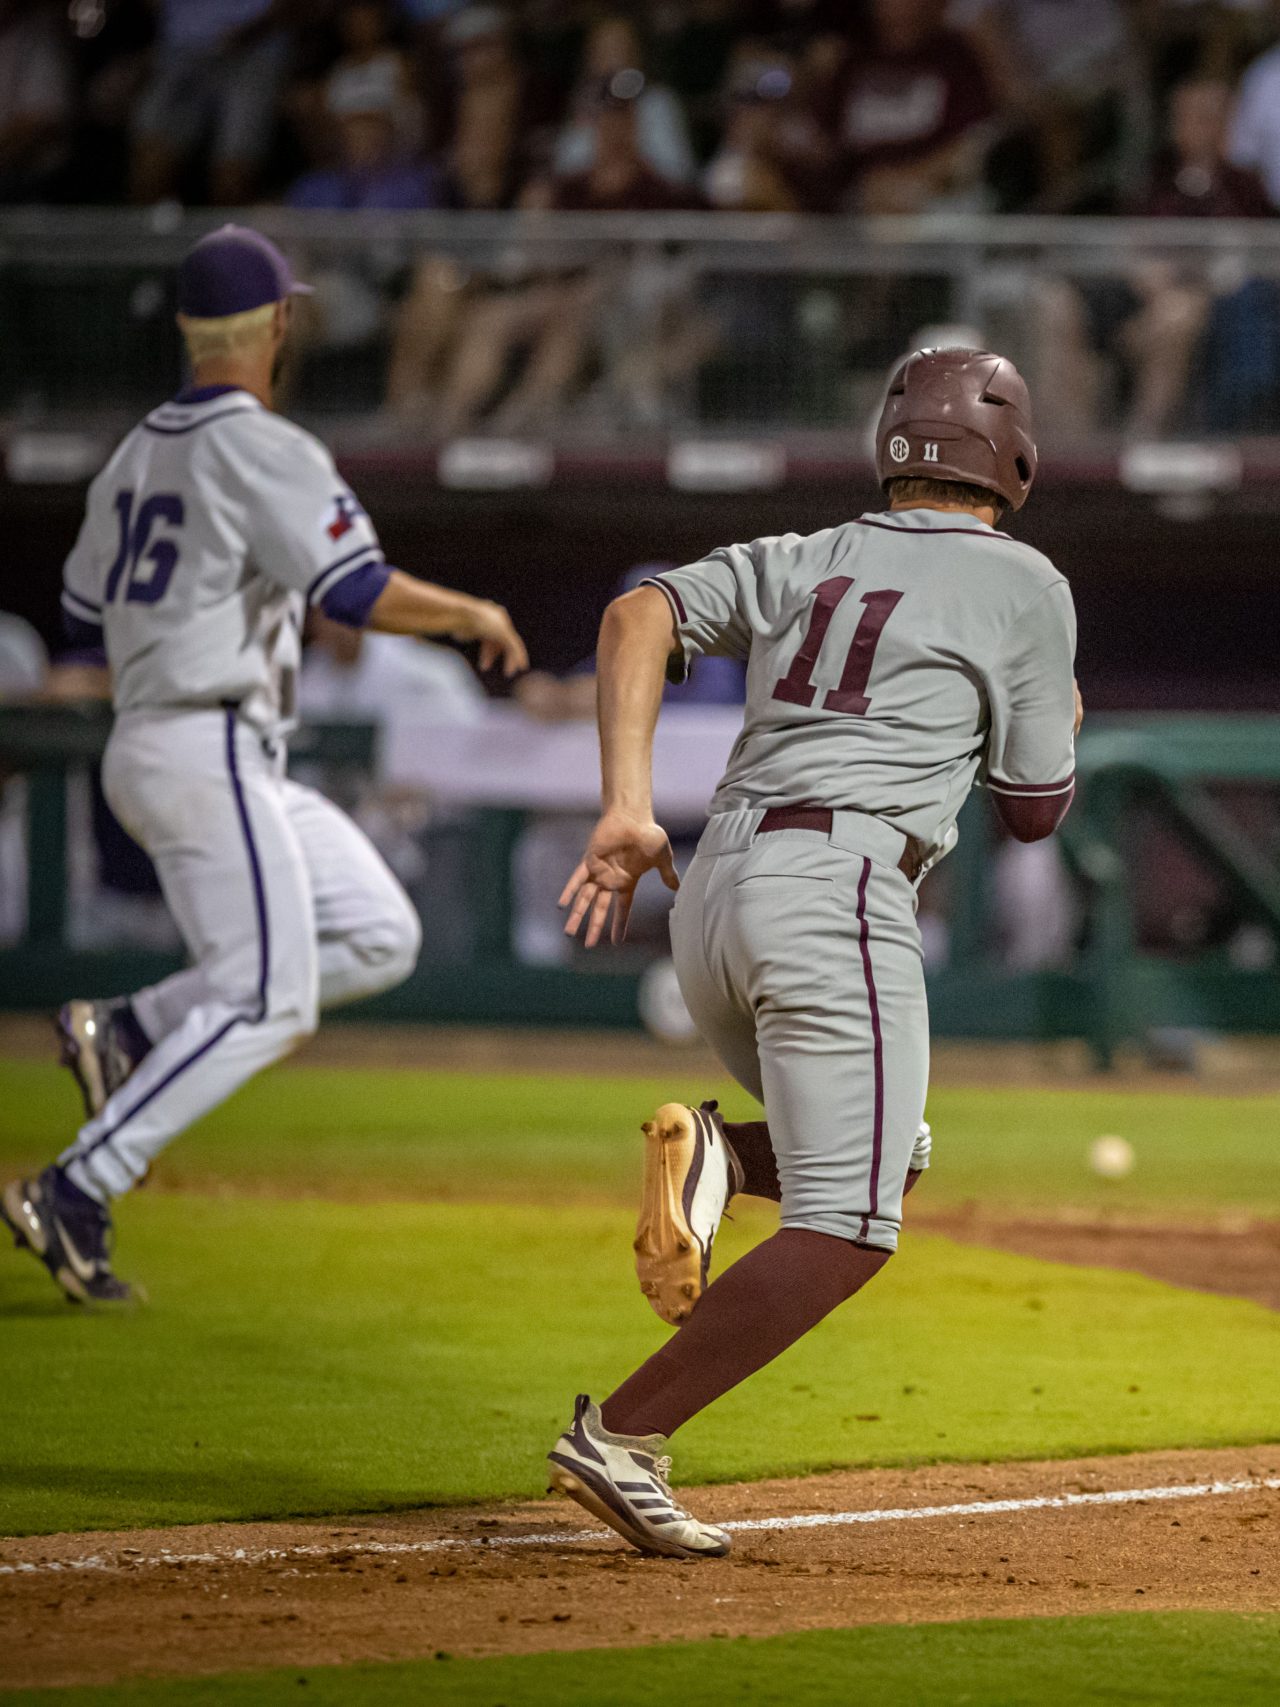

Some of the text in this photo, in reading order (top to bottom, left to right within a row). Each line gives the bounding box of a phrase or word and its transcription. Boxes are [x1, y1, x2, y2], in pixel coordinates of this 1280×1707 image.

[891, 437, 909, 461] SEC
[923, 442, 939, 462] 11
[105, 490, 184, 604] 16
[771, 575, 905, 716] 11
